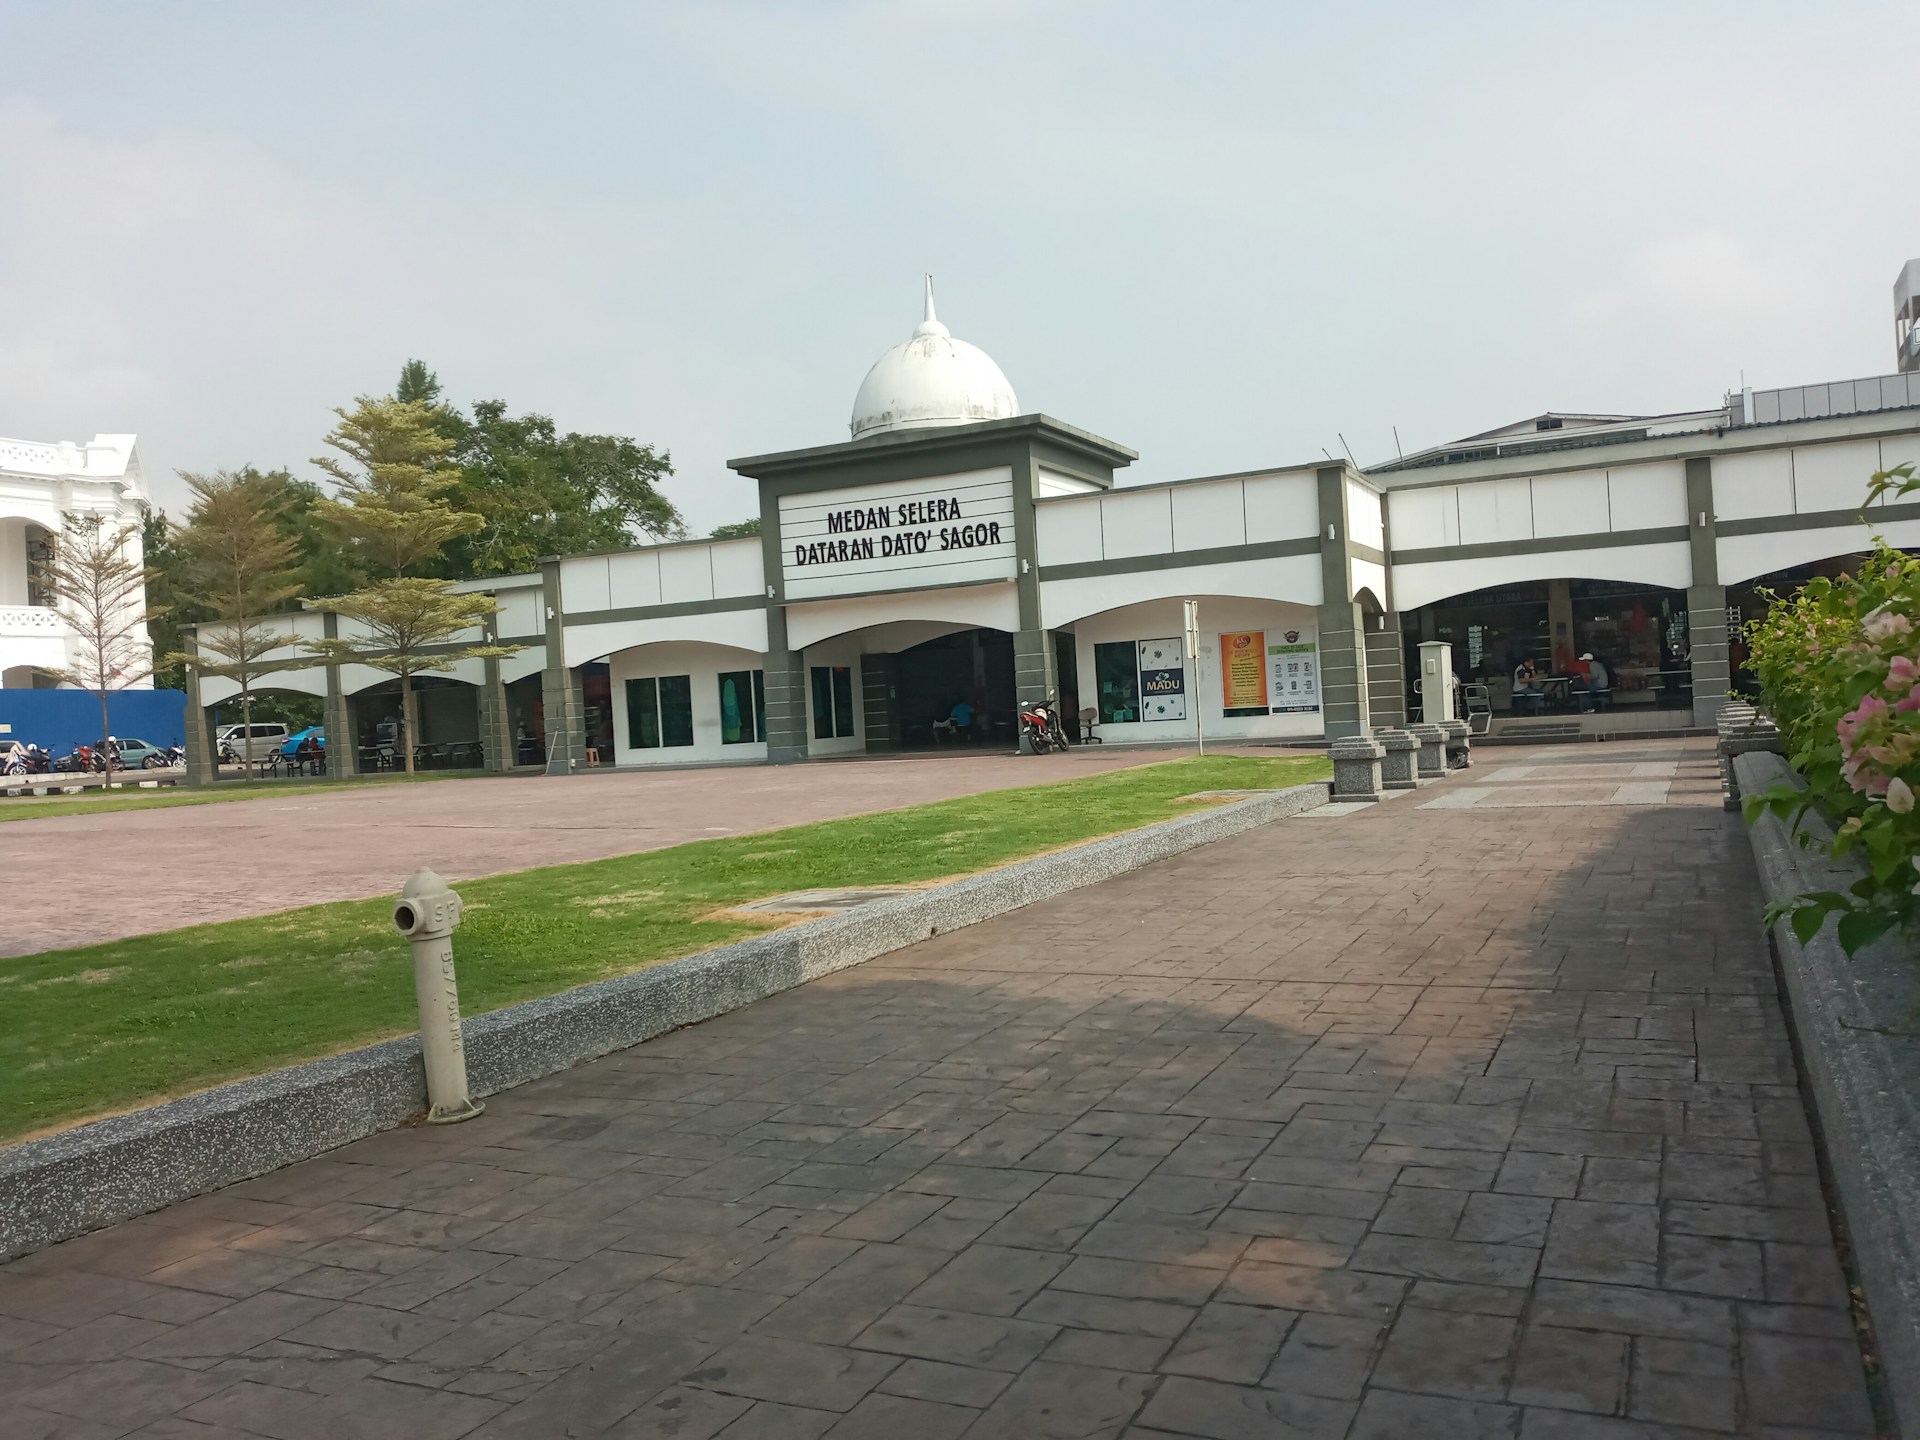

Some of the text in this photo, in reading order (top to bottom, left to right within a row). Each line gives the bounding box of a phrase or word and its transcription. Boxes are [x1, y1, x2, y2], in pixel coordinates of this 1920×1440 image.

[827, 497, 961, 534] MEDAN SELERA
[795, 521, 1001, 566] DATARAN DATO' SAGOR
[1146, 679, 1180, 691] MADU
